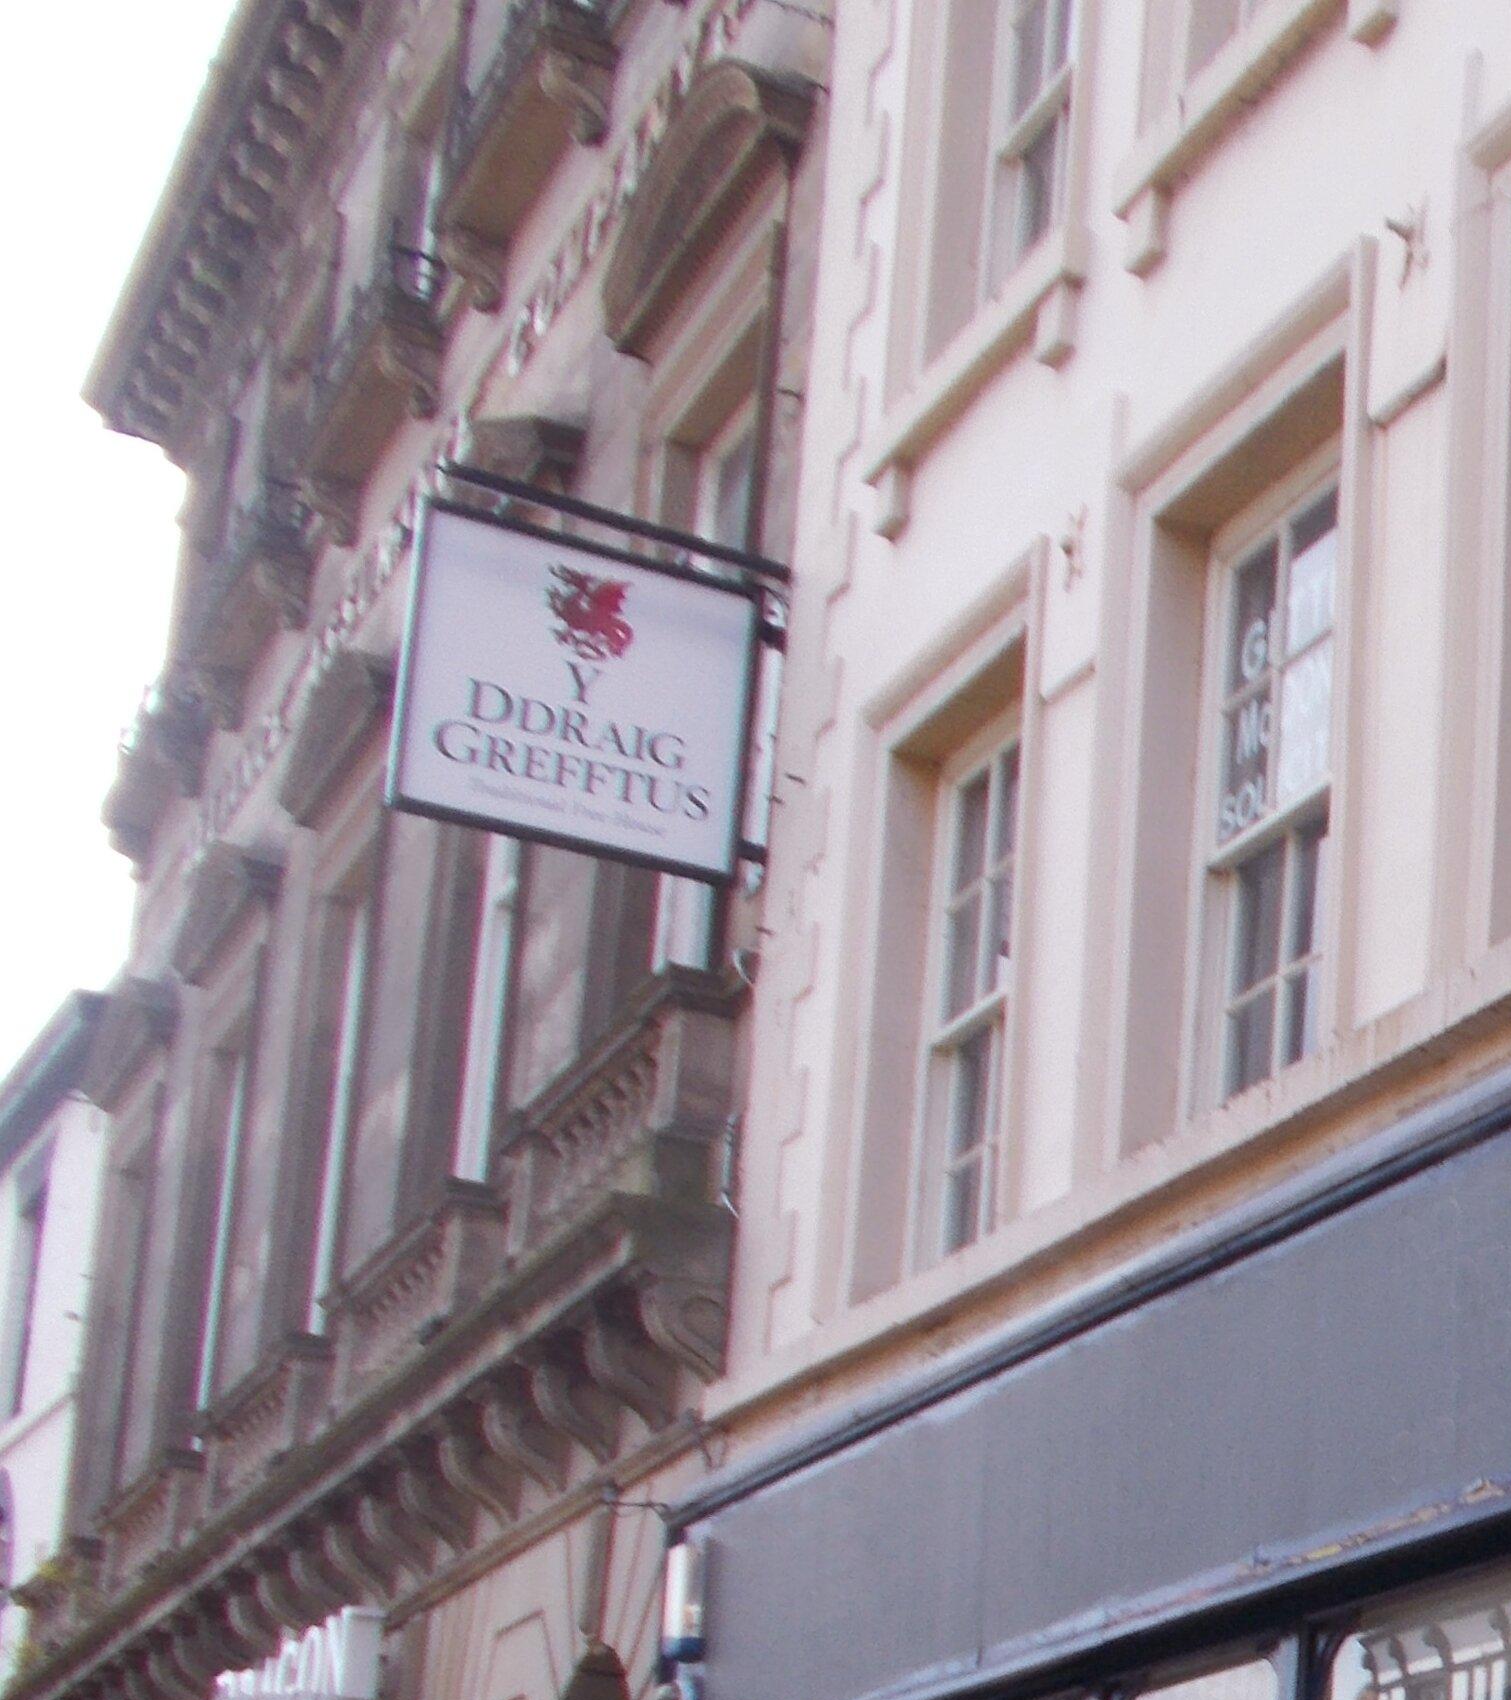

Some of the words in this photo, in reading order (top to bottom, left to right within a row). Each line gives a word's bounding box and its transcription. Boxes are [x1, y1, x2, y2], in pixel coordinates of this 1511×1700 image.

[468, 677, 686, 769] DDRAIG
[565, 659, 604, 704] Y
[432, 719, 711, 822] GREFFTUS
